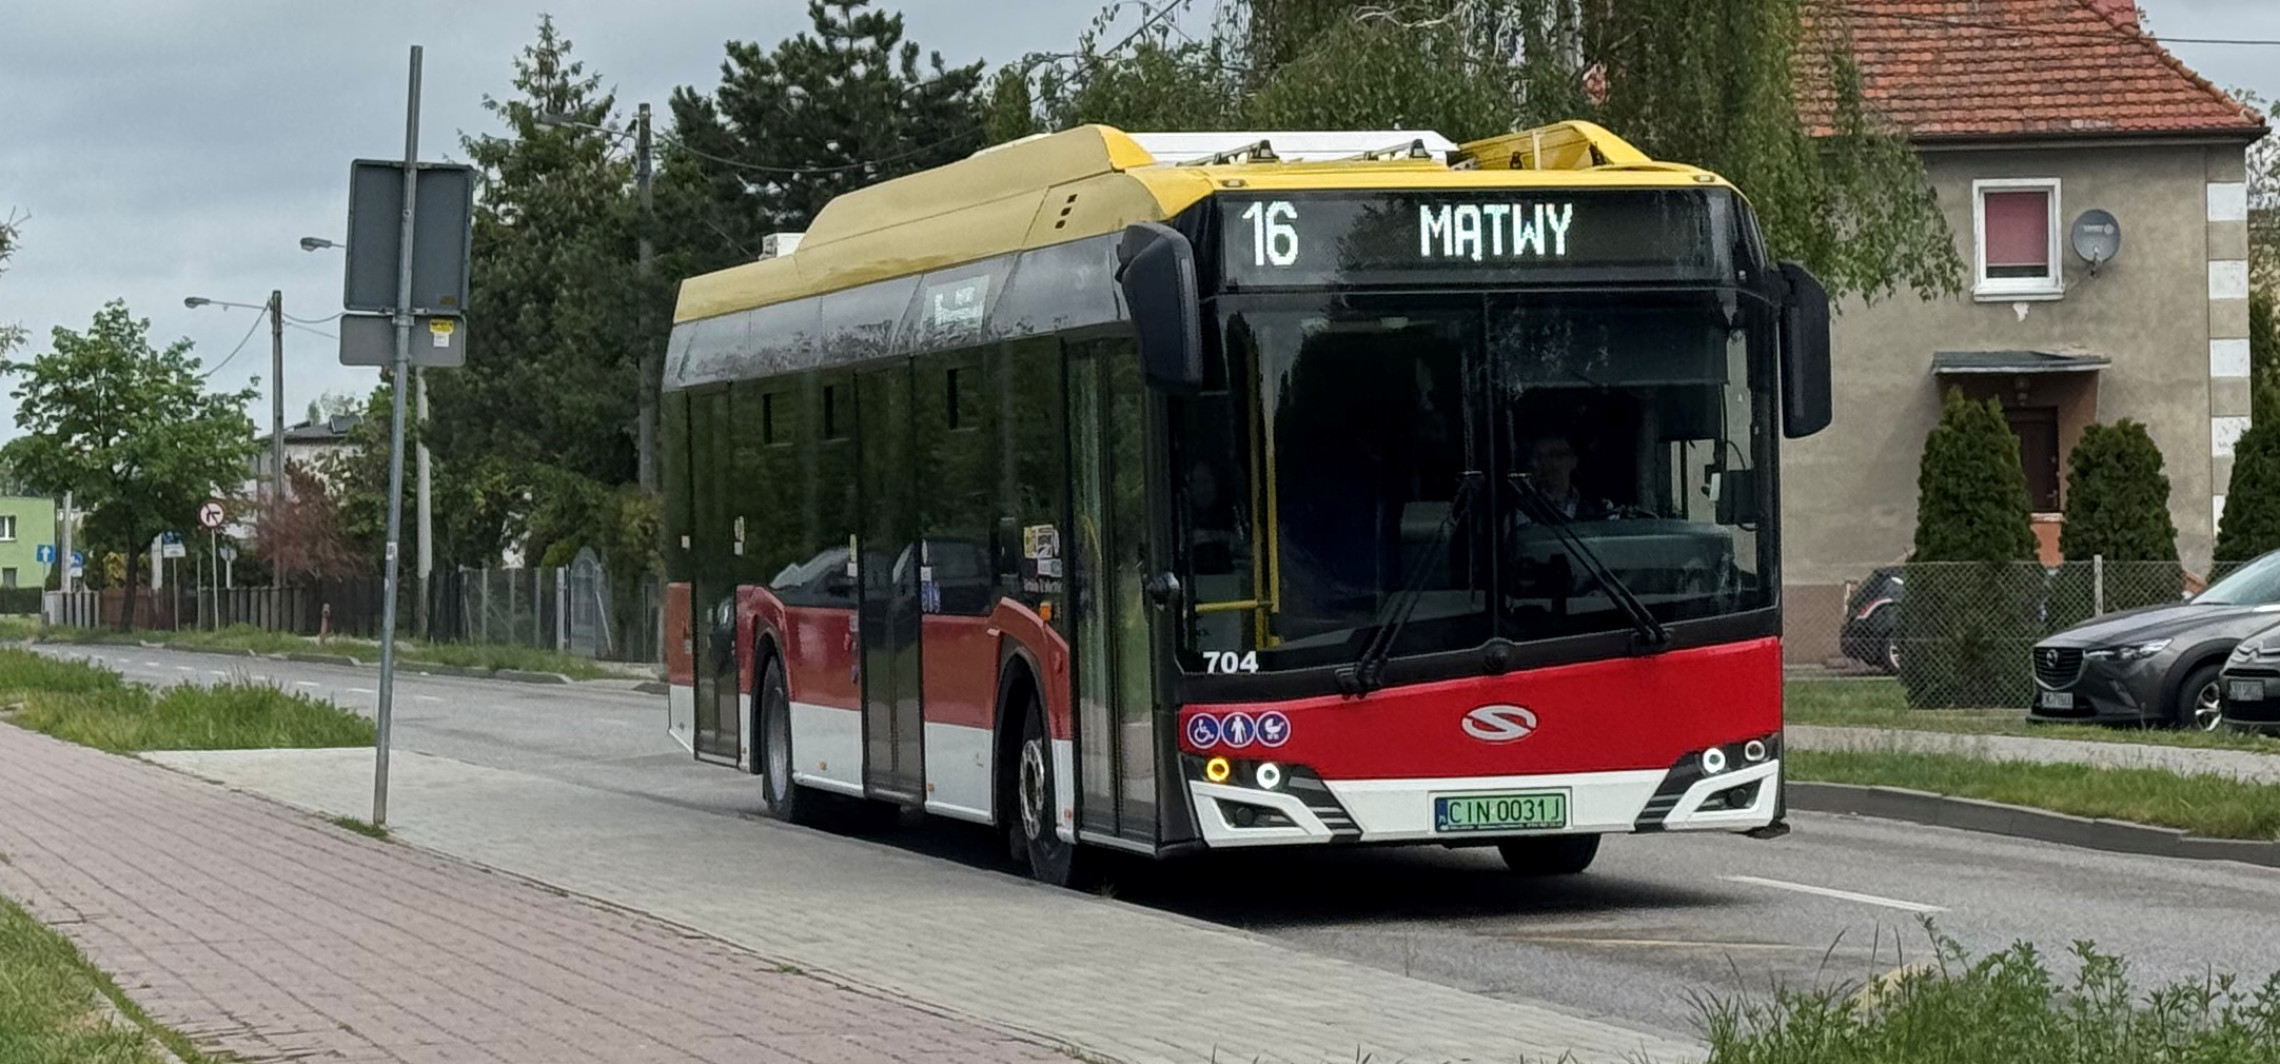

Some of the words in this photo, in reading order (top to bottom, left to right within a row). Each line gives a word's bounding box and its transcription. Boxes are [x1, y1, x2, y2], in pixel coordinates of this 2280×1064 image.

[1242, 201, 1299, 266] 16
[1420, 203, 1574, 261] MĄTWY
[1203, 651, 1259, 674] 704
[1450, 801, 1490, 823] CIN
[1497, 798, 1560, 822] 0031J
